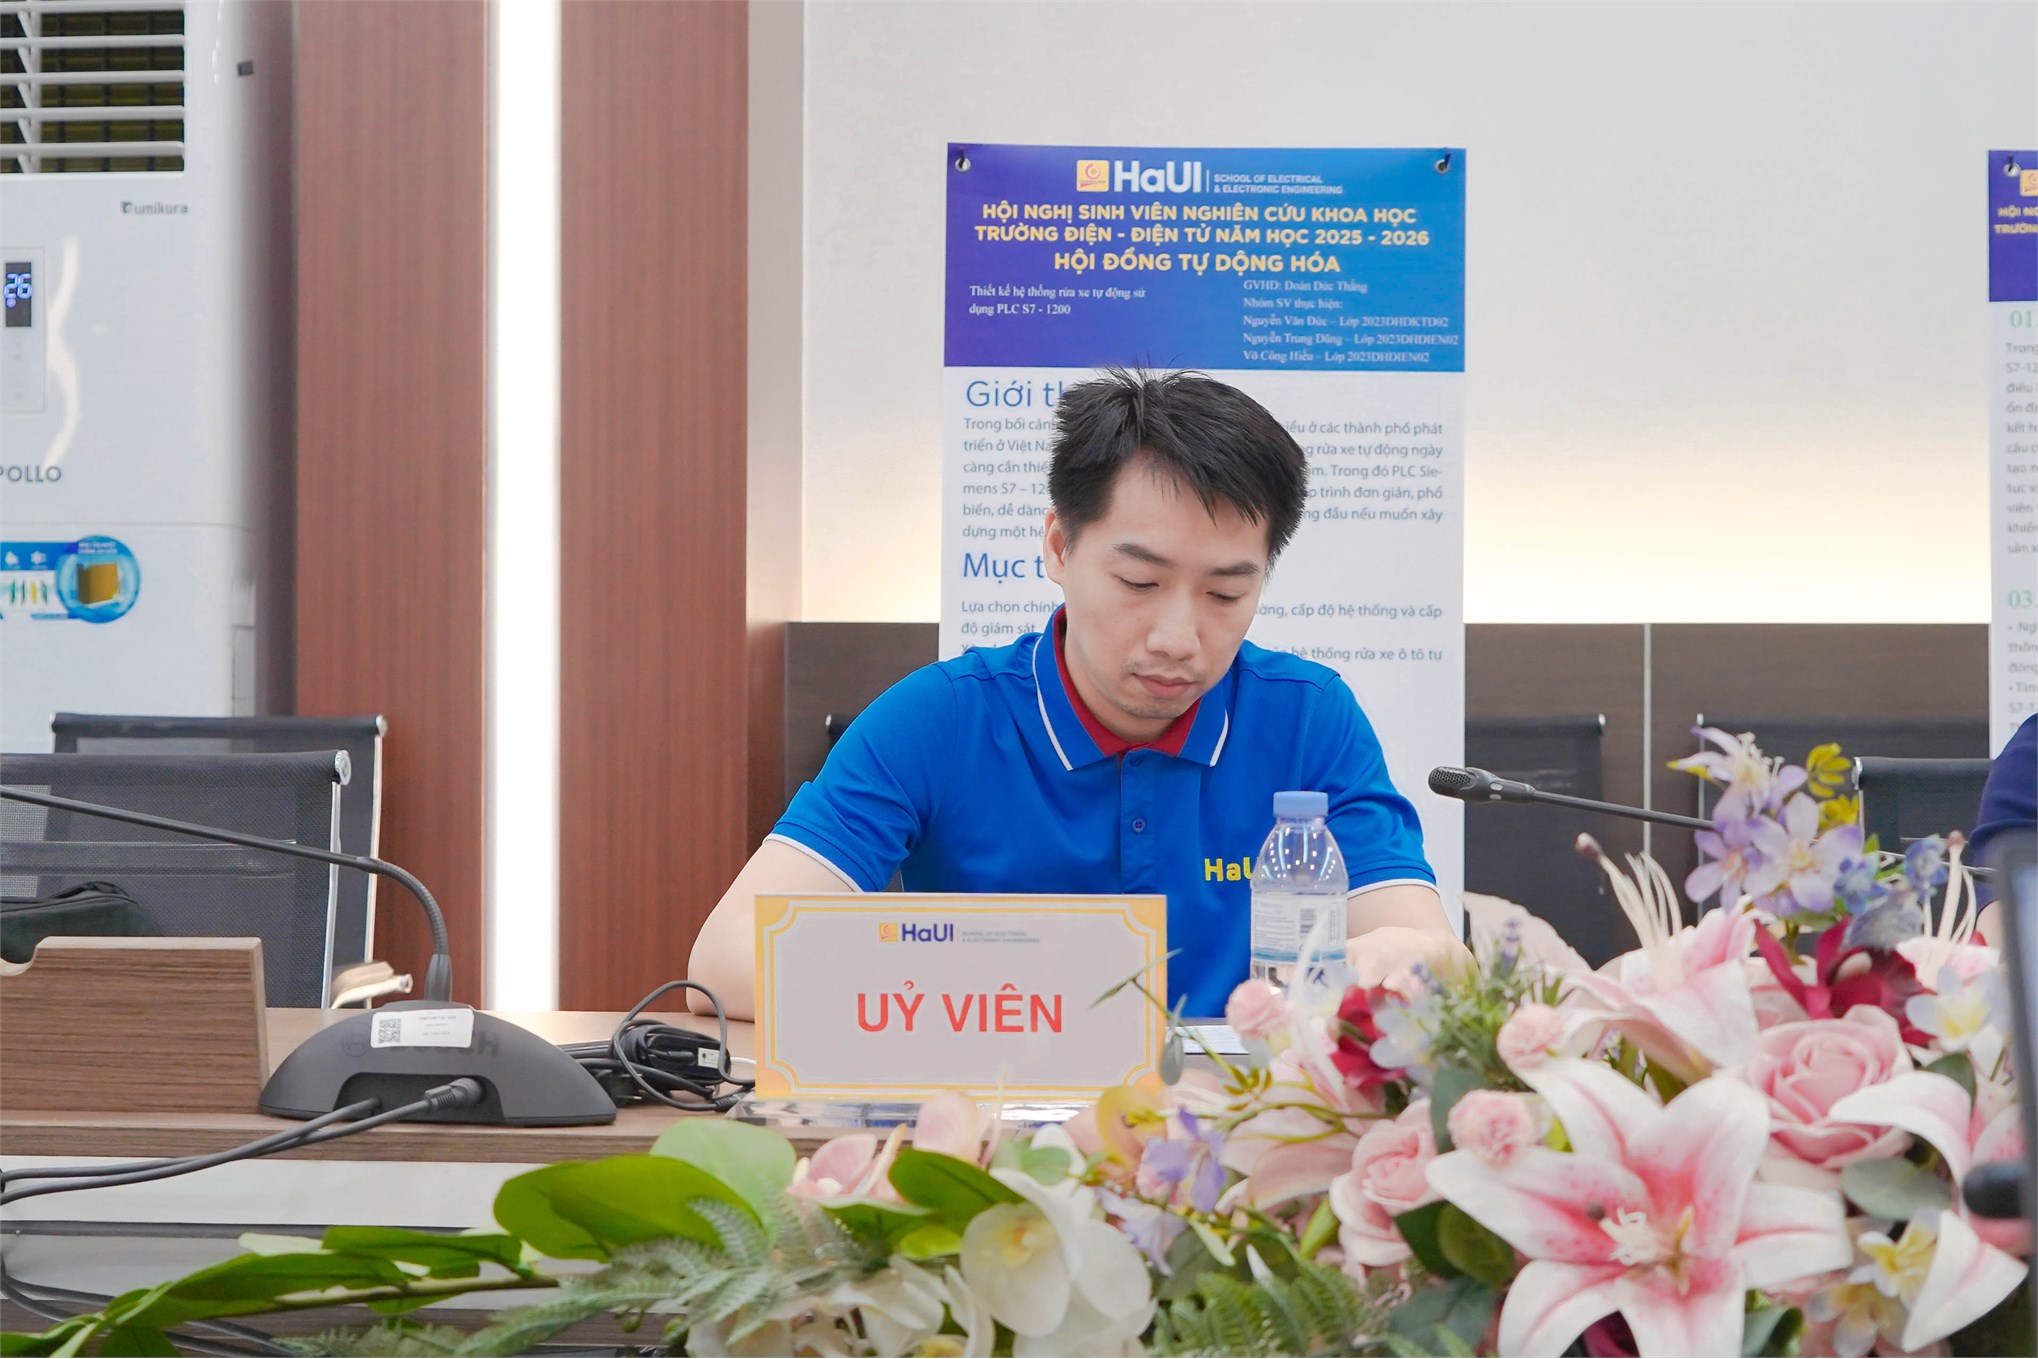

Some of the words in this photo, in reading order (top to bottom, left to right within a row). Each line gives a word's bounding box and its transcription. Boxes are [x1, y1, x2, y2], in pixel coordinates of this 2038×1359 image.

[1114, 160, 1202, 193] HaUI
[1214, 174, 1251, 183] SCHOOL
[1254, 174, 1265, 183] OF
[1268, 175, 1322, 183] ELECTRICAL
[1214, 185, 1220, 193] &
[1223, 185, 1279, 193] ELECTRONIC
[1282, 185, 1343, 194] ENGINEERING
[983, 200, 1018, 222] HỘI
[1024, 204, 1072, 223] NGHỊ
[1078, 205, 1124, 220] SINH
[1130, 202, 1177, 220] VIÊN
[1183, 202, 1259, 221] NGHIÊN
[1264, 203, 1305, 222] CỨU
[1311, 208, 1368, 223] KHOA
[1373, 208, 1417, 227] HỌC
[975, 222, 1059, 241] TRƯỜNG
[1064, 223, 1112, 246] ĐIỆN
[1131, 223, 1178, 246] ĐIỆN
[1184, 224, 1210, 243] TỬ
[1216, 225, 1260, 243] NĂM
[1266, 229, 1309, 248] HỌC
[1315, 230, 1363, 245] 2025
[1381, 231, 1430, 246] 2026
[1054, 248, 1095, 275] HỘI
[1178, 252, 1210, 276] TỰ
[1291, 251, 1341, 273] HÓA
[4, 273, 32, 299] 26
[969, 284, 996, 297] Thiết
[998, 284, 1011, 297] kế
[1013, 286, 1025, 299] hệ
[1027, 284, 1056, 300] thống
[1058, 287, 1075, 298] rửa
[1078, 289, 1090, 298] xe
[1092, 287, 1104, 300] tự
[1105, 287, 1131, 301] động
[1243, 280, 1282, 291] GVHD:
[968, 304, 995, 317] dụng
[997, 304, 1020, 315] PLC
[1022, 304, 1036, 315] S7
[1046, 304, 1071, 316] 1200
[1243, 298, 1274, 308] Nhóm
[1276, 298, 1292, 308] SV
[1243, 313, 1282, 328] Nguyễn
[1340, 316, 1359, 328] Lớp
[1243, 331, 1282, 345] Nguyễn
[1285, 333, 1313, 346] Trung
[1354, 334, 1374, 346] Lớp
[1261, 350, 1287, 363] Công
[1325, 351, 1345, 363] Lớp
[966, 380, 1032, 407] Giới
[964, 418, 1001, 432] Trong
[1005, 417, 1025, 430] bối
[1308, 421, 1317, 434] ở
[1320, 422, 1341, 434] các
[1344, 421, 1382, 434] thành
[1385, 421, 1411, 437] phố
[1413, 423, 1443, 437] phát
[963, 438, 993, 451] triển
[996, 440, 1005, 452] ở
[1007, 440, 1032, 454] Việt
[1317, 443, 1338, 455] rửa
[1340, 446, 1355, 455] xe
[1358, 445, 1373, 457] tự
[1374, 444, 1408, 459] động
[1411, 445, 1443, 459] ngày
[963, 461, 994, 476] càng
[997, 461, 1020, 473] cần
[1023, 461, 1049, 473] thiế
[1331, 465, 1369, 480] Trong
[1372, 465, 1389, 478] đó
[1392, 465, 1416, 478] PLC
[1420, 465, 1443, 478] Sie-
[963, 484, 998, 495] mens
[1002, 483, 1017, 495] S7
[1320, 486, 1350, 499] trình
[1354, 486, 1380, 499] đơn
[1382, 487, 1414, 502] giản,
[963, 504, 995, 517] biến,
[997, 503, 1014, 516] dễ
[1323, 508, 1348, 520] đầu
[1351, 507, 1376, 520] nếu
[1379, 508, 1417, 520] muốn
[1421, 509, 1443, 524] xây
[962, 526, 996, 541] dựng
[1000, 526, 1026, 540] một
[963, 553, 1026, 584] Mục
[961, 601, 984, 614] Lựa
[988, 601, 1020, 614] chọn
[1291, 603, 1314, 619] cấp
[1318, 604, 1335, 619] độ
[1338, 604, 1355, 619] hệ
[1358, 604, 1398, 619] thống
[1400, 605, 1416, 617] và
[1419, 603, 1442, 619] cấp
[961, 622, 978, 635] độ
[981, 622, 1014, 637] giám
[1017, 622, 1036, 634] sát
[1312, 647, 1350, 662] thống
[1355, 647, 1376, 661] rửa
[1379, 651, 1395, 661] xe
[1399, 648, 1407, 661] ô
[1411, 648, 1424, 661] tô
[1429, 649, 1443, 663] tự
[1204, 856, 1253, 883] HaU
[901, 923, 954, 942] HaUI
[856, 980, 925, 1032] UỶ
[941, 983, 1063, 1033] VIÊN
